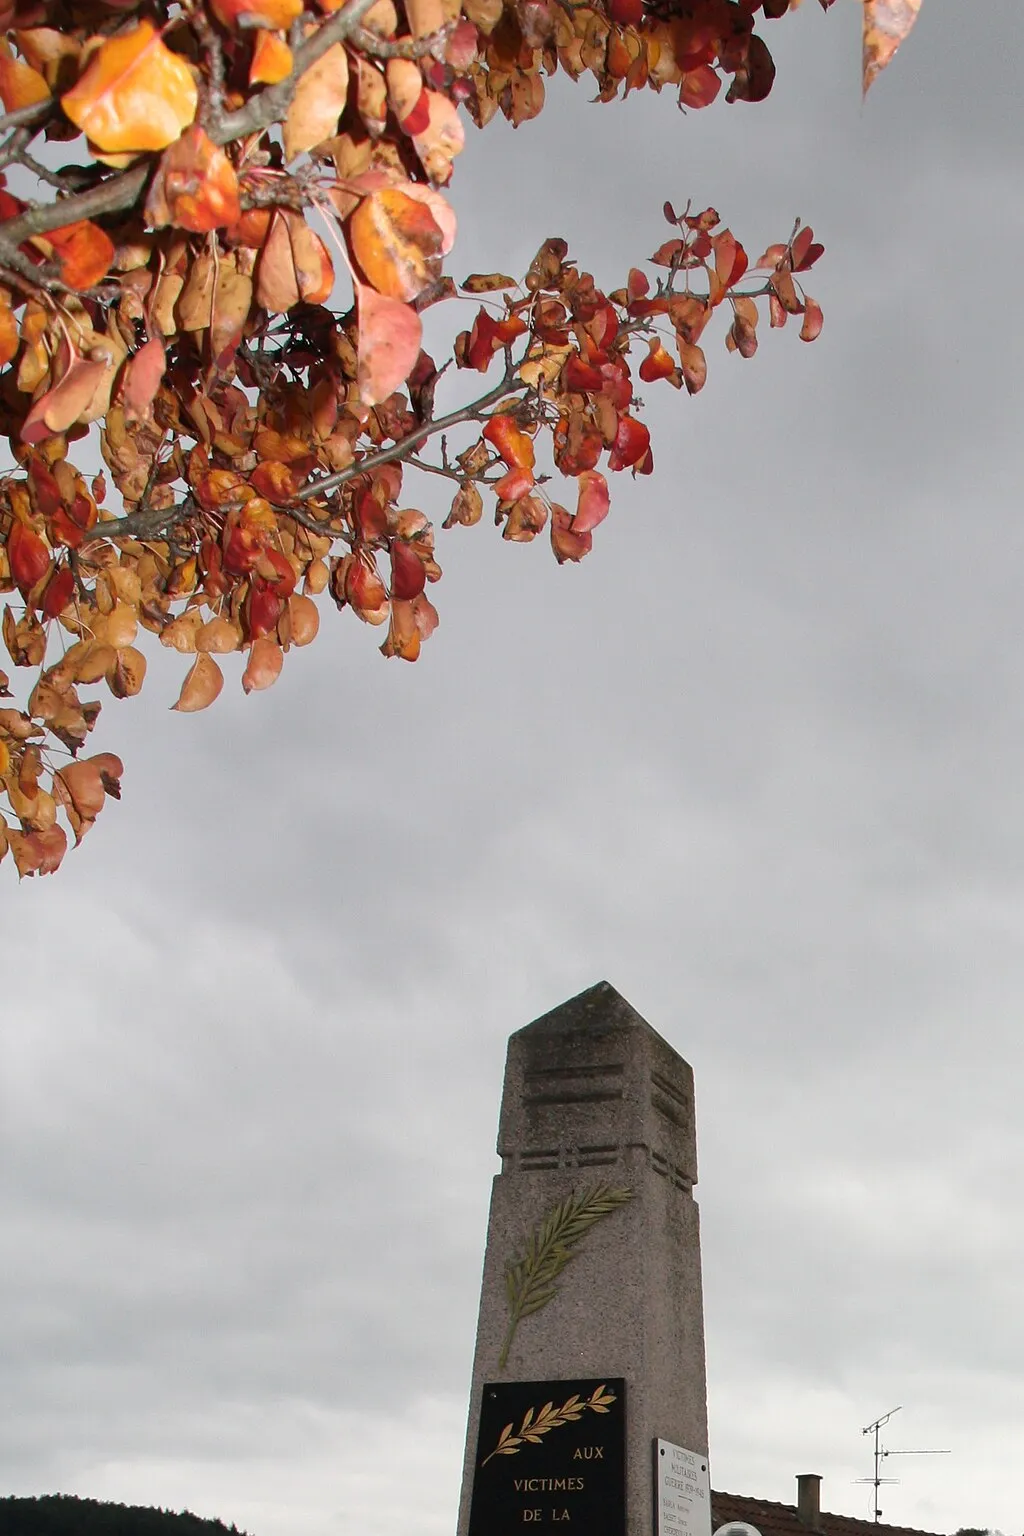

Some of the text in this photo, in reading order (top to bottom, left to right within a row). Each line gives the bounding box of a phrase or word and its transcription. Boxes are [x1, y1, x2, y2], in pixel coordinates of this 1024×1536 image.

[573, 1446, 604, 1460] AUX
[514, 1477, 584, 1492] VICTIMES
[523, 1509, 570, 1522] DE LA
